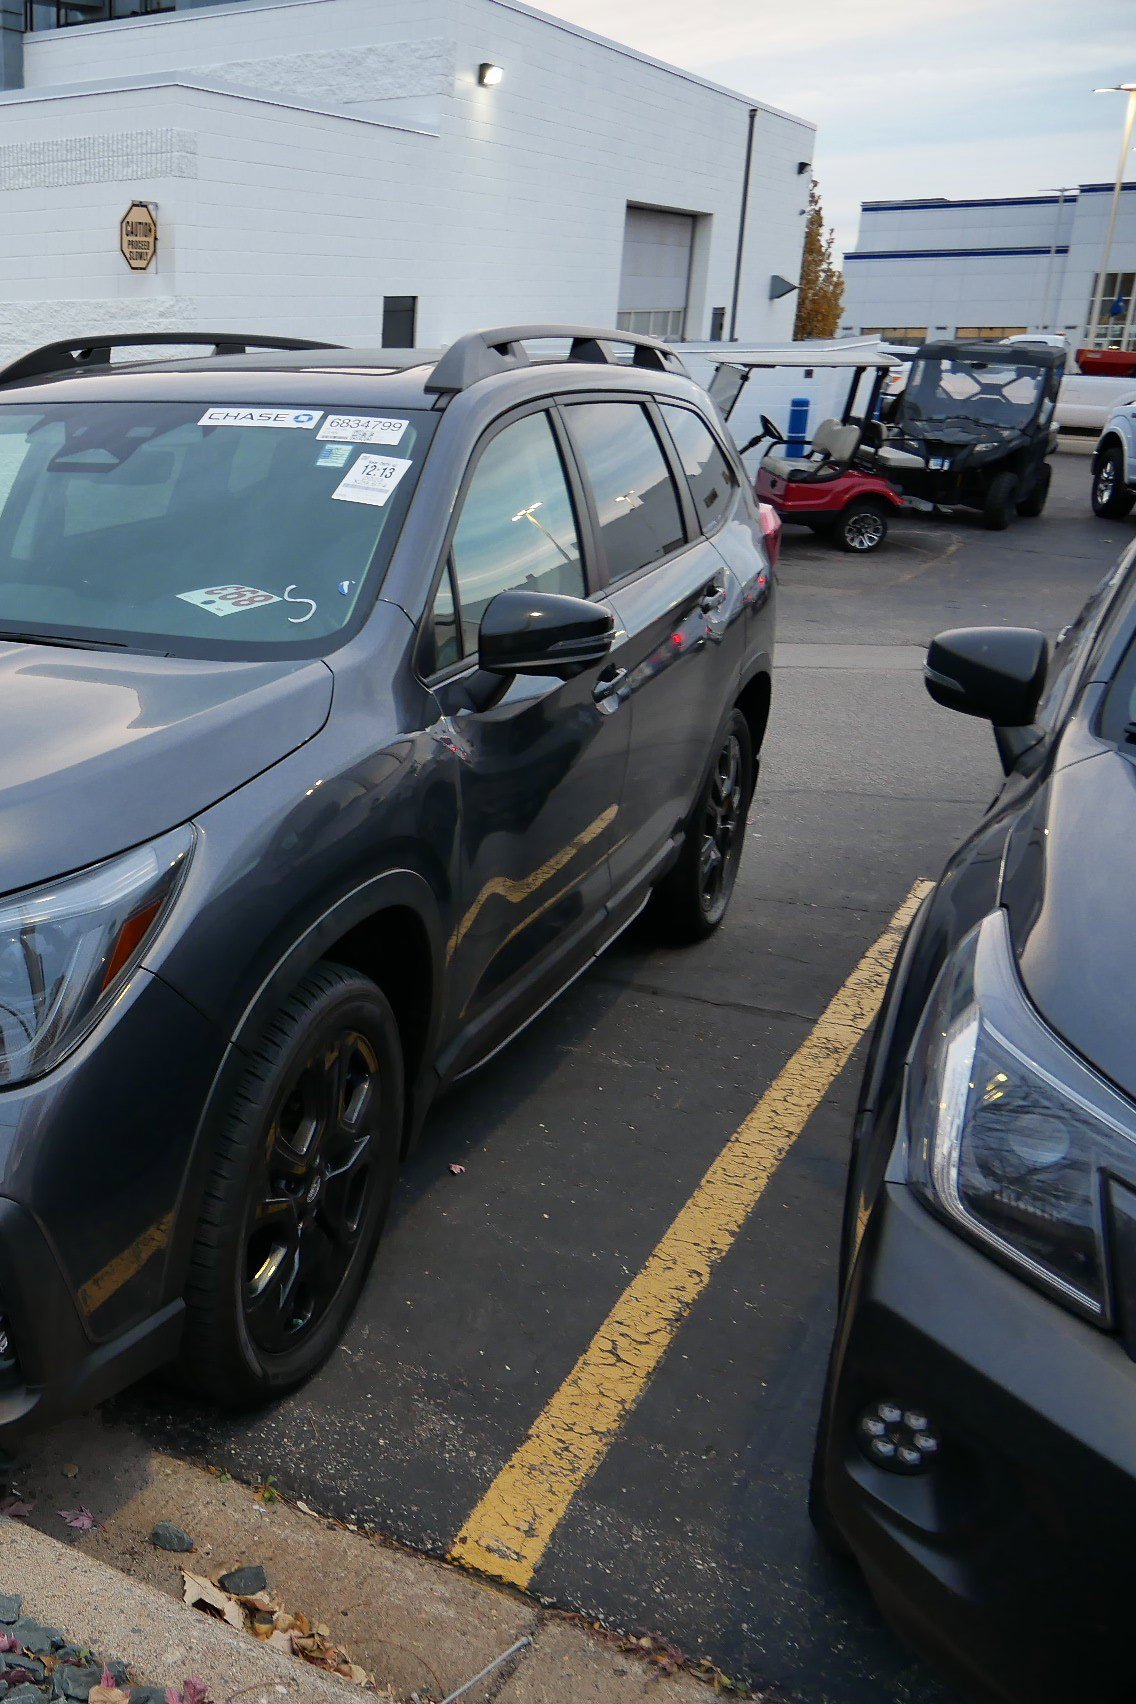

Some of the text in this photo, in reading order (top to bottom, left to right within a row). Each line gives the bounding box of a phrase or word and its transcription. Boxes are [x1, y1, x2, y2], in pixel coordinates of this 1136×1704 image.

[125, 221, 152, 238] CAUTION
[127, 239, 150, 250] PROCEED
[128, 250, 149, 261] SLOWLY
[208, 412, 289, 422] CHASE
[329, 418, 403, 432] 6834799
